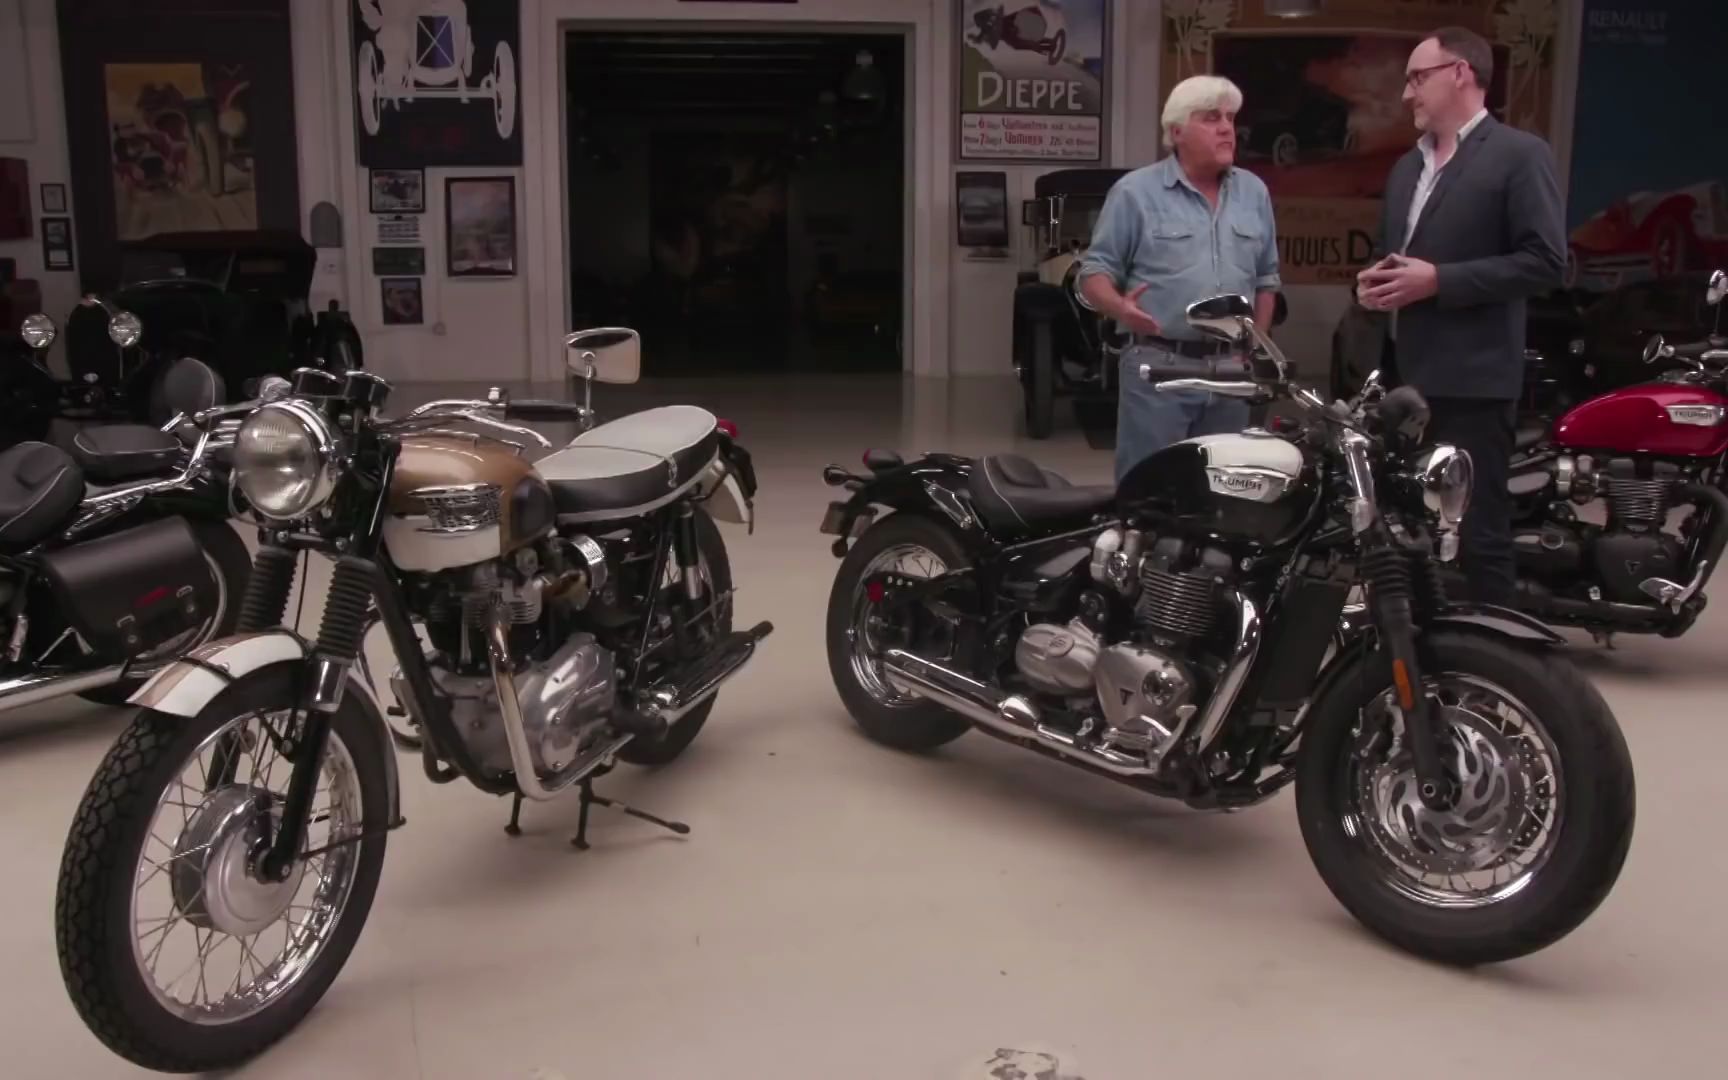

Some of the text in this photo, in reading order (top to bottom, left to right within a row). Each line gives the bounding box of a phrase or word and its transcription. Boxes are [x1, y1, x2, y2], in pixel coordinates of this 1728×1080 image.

[1588, 9, 1667, 30] RENAULT
[978, 71, 1083, 110] DIEPPE
[1213, 474, 1262, 491] TRIUMPH
